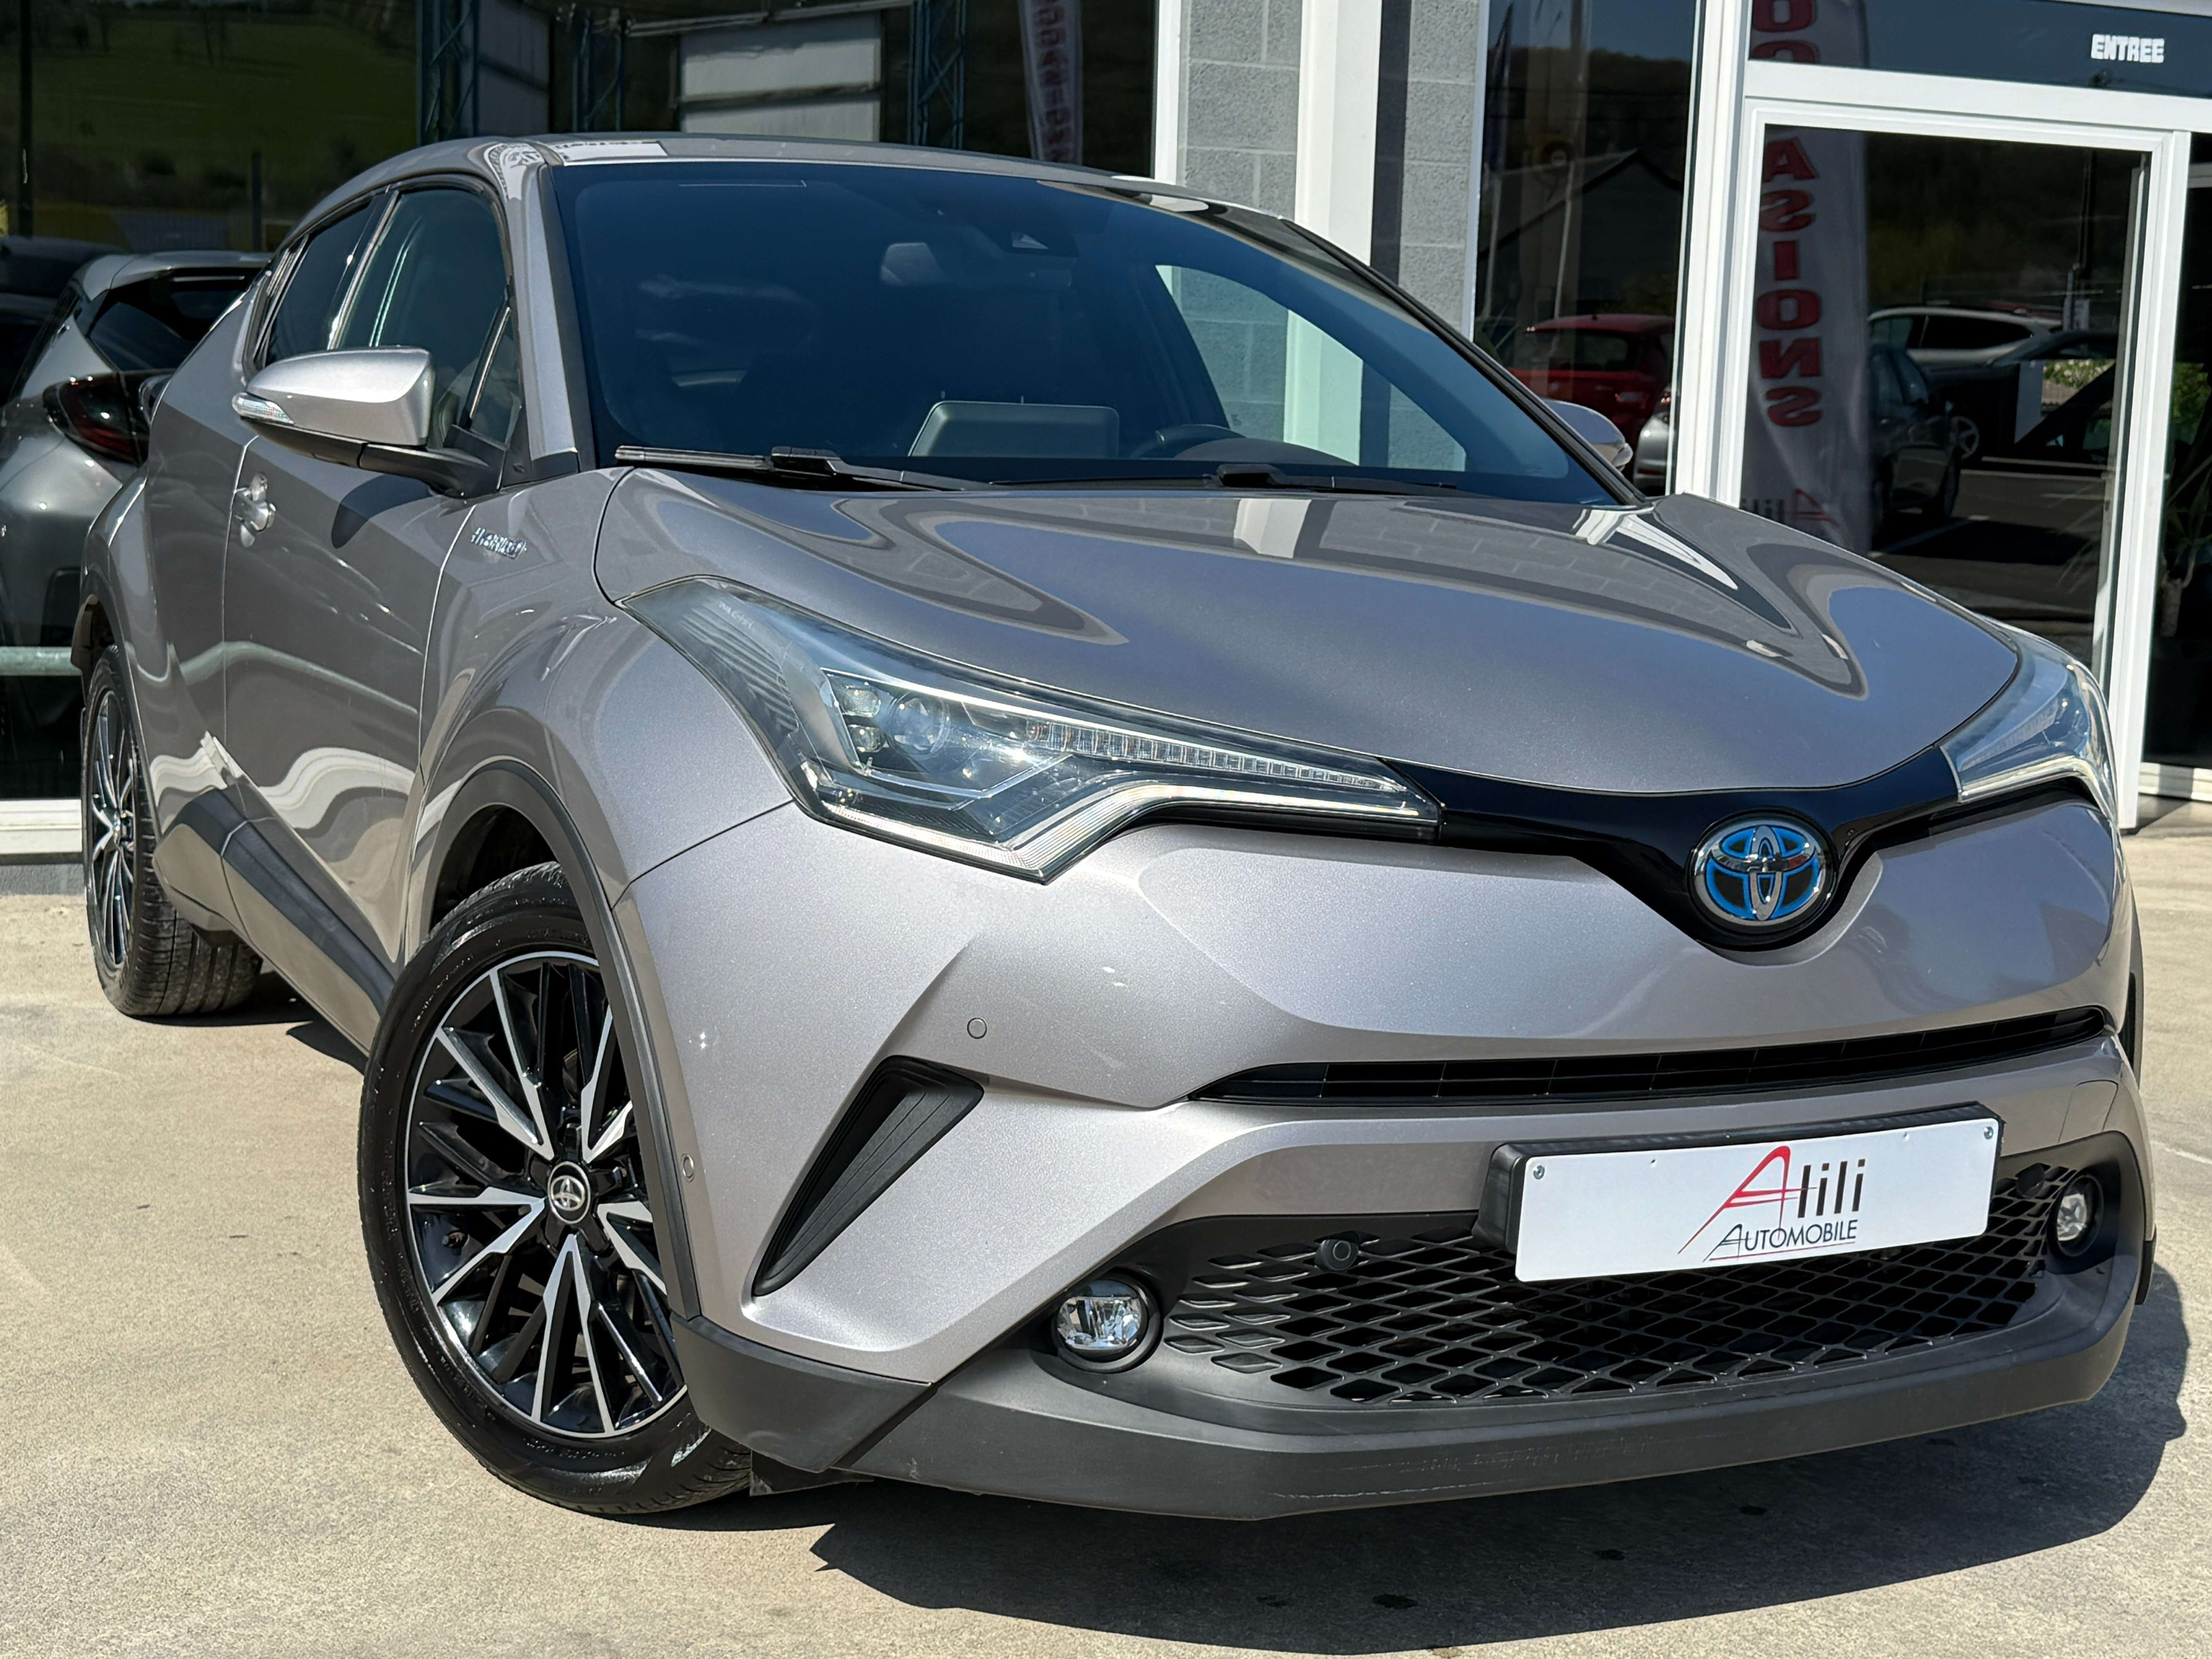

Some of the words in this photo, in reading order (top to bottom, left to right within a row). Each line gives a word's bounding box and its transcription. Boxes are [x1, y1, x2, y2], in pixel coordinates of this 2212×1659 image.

[2091, 34, 2165, 63] ENTREE
[1678, 1145, 1865, 1255] Alili
[1702, 1219, 1858, 1262] AUTOMOBILE
